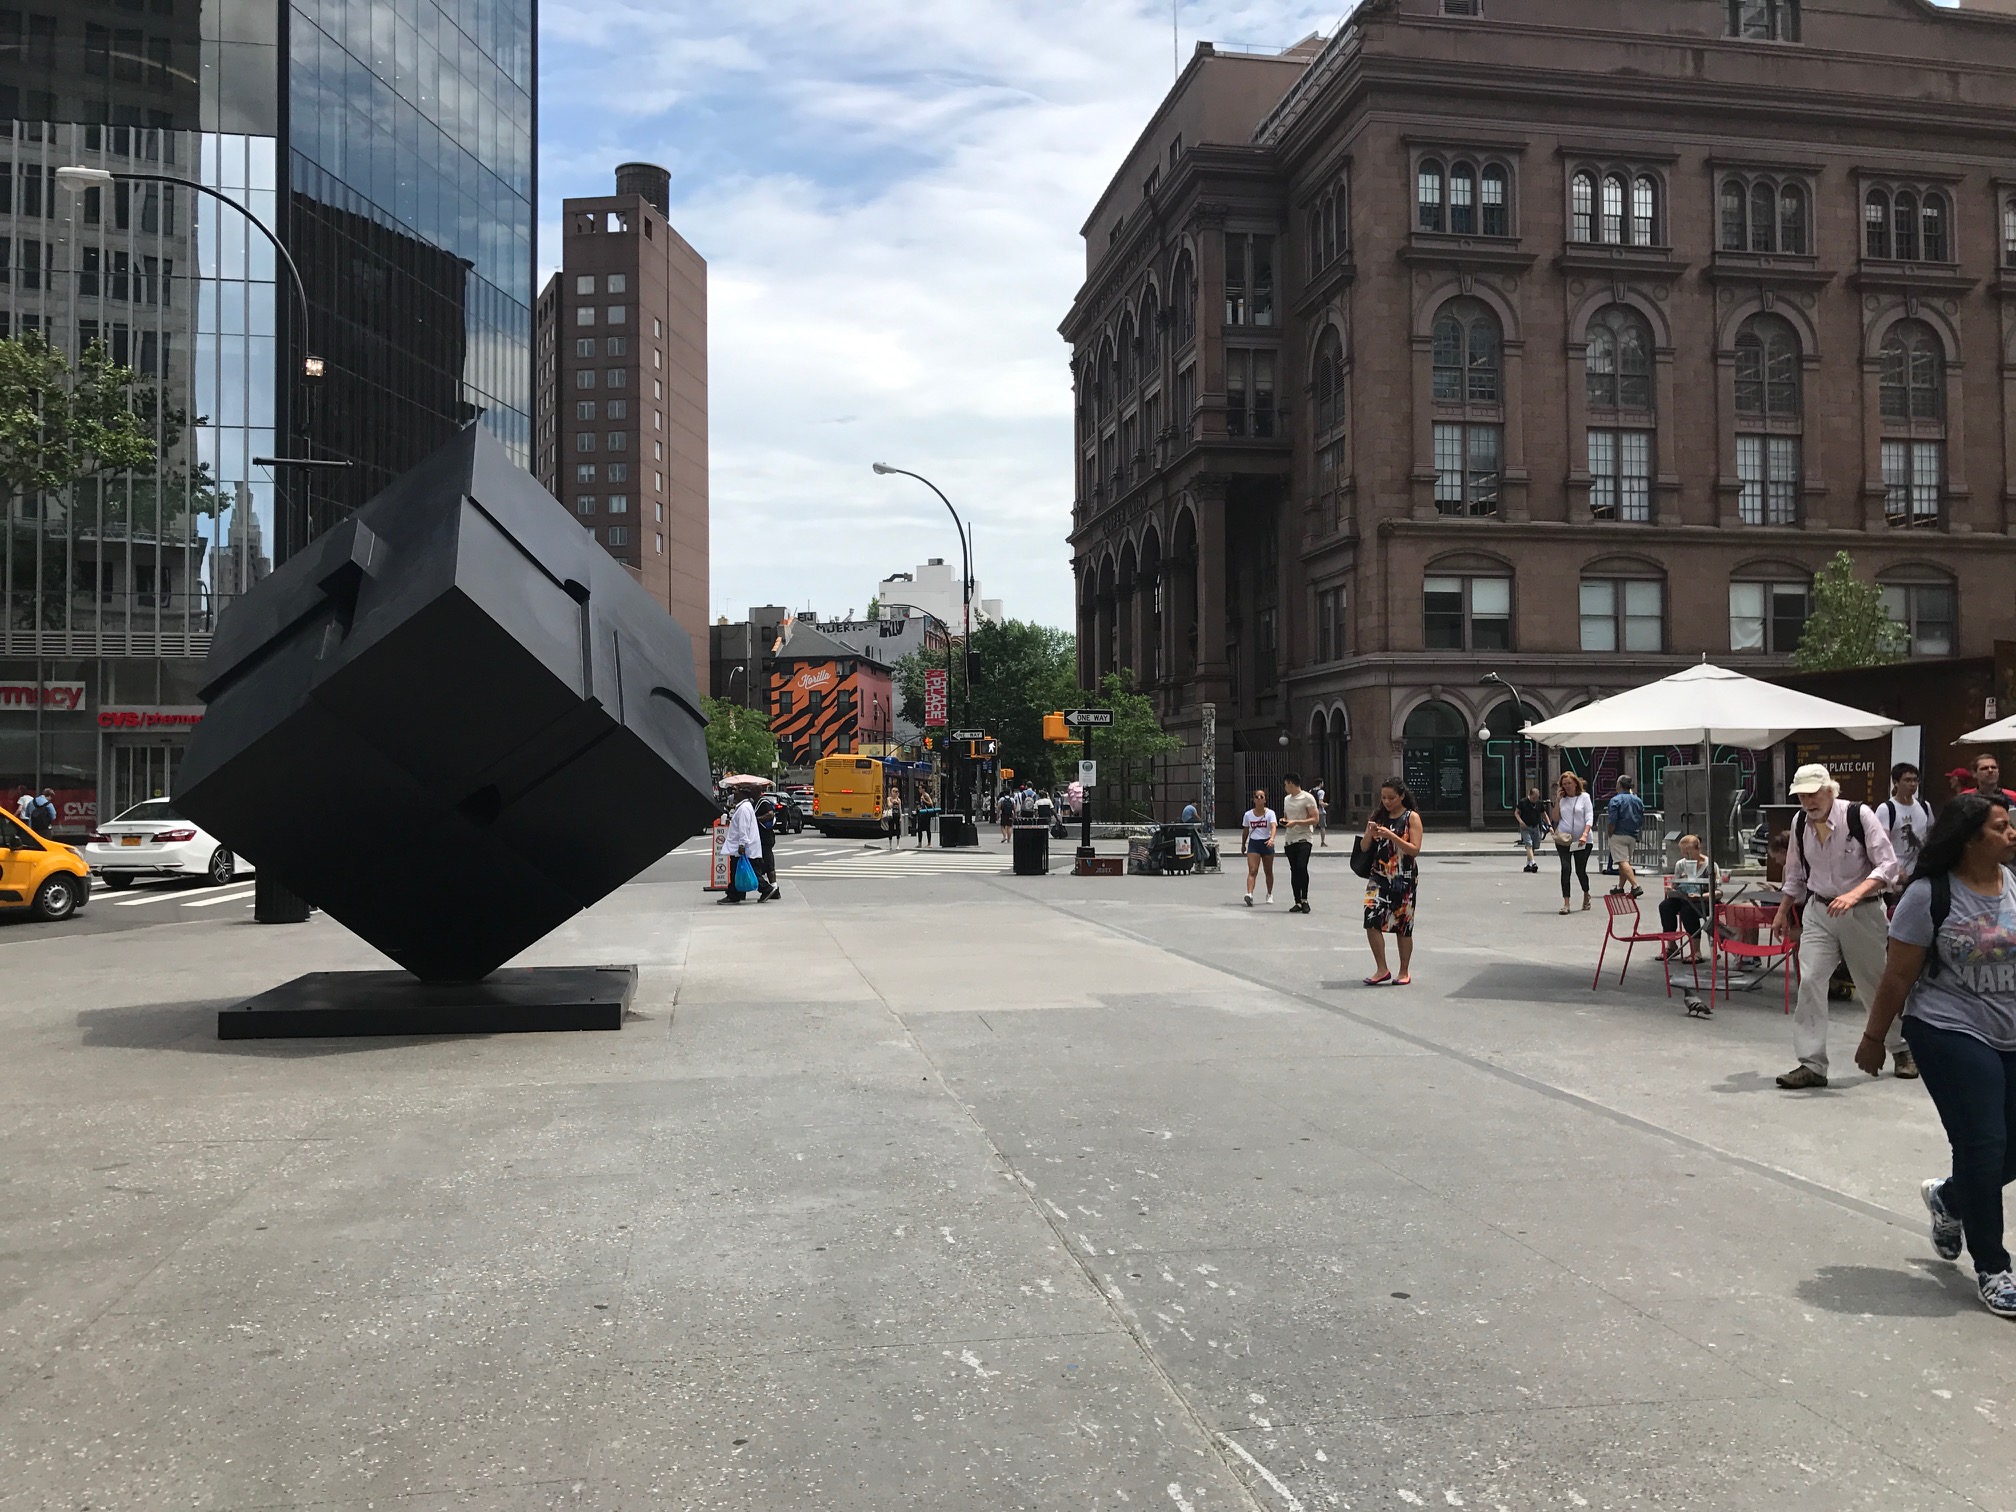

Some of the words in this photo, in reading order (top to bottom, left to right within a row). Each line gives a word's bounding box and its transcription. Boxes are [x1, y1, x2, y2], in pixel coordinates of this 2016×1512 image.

[1125, 493, 1147, 518] UNION
[798, 669, 831, 690] Korilla
[930, 677, 942, 719] PLACE
[98, 712, 205, 727] CVS/pharmac
[1076, 714, 1090, 722] ONE
[1093, 714, 1108, 722] WAY
[1829, 762, 1853, 772] PLATE
[1855, 761, 1875, 772] CAF
[64, 801, 97, 815] CVS
[1951, 963, 2016, 993] MAR
